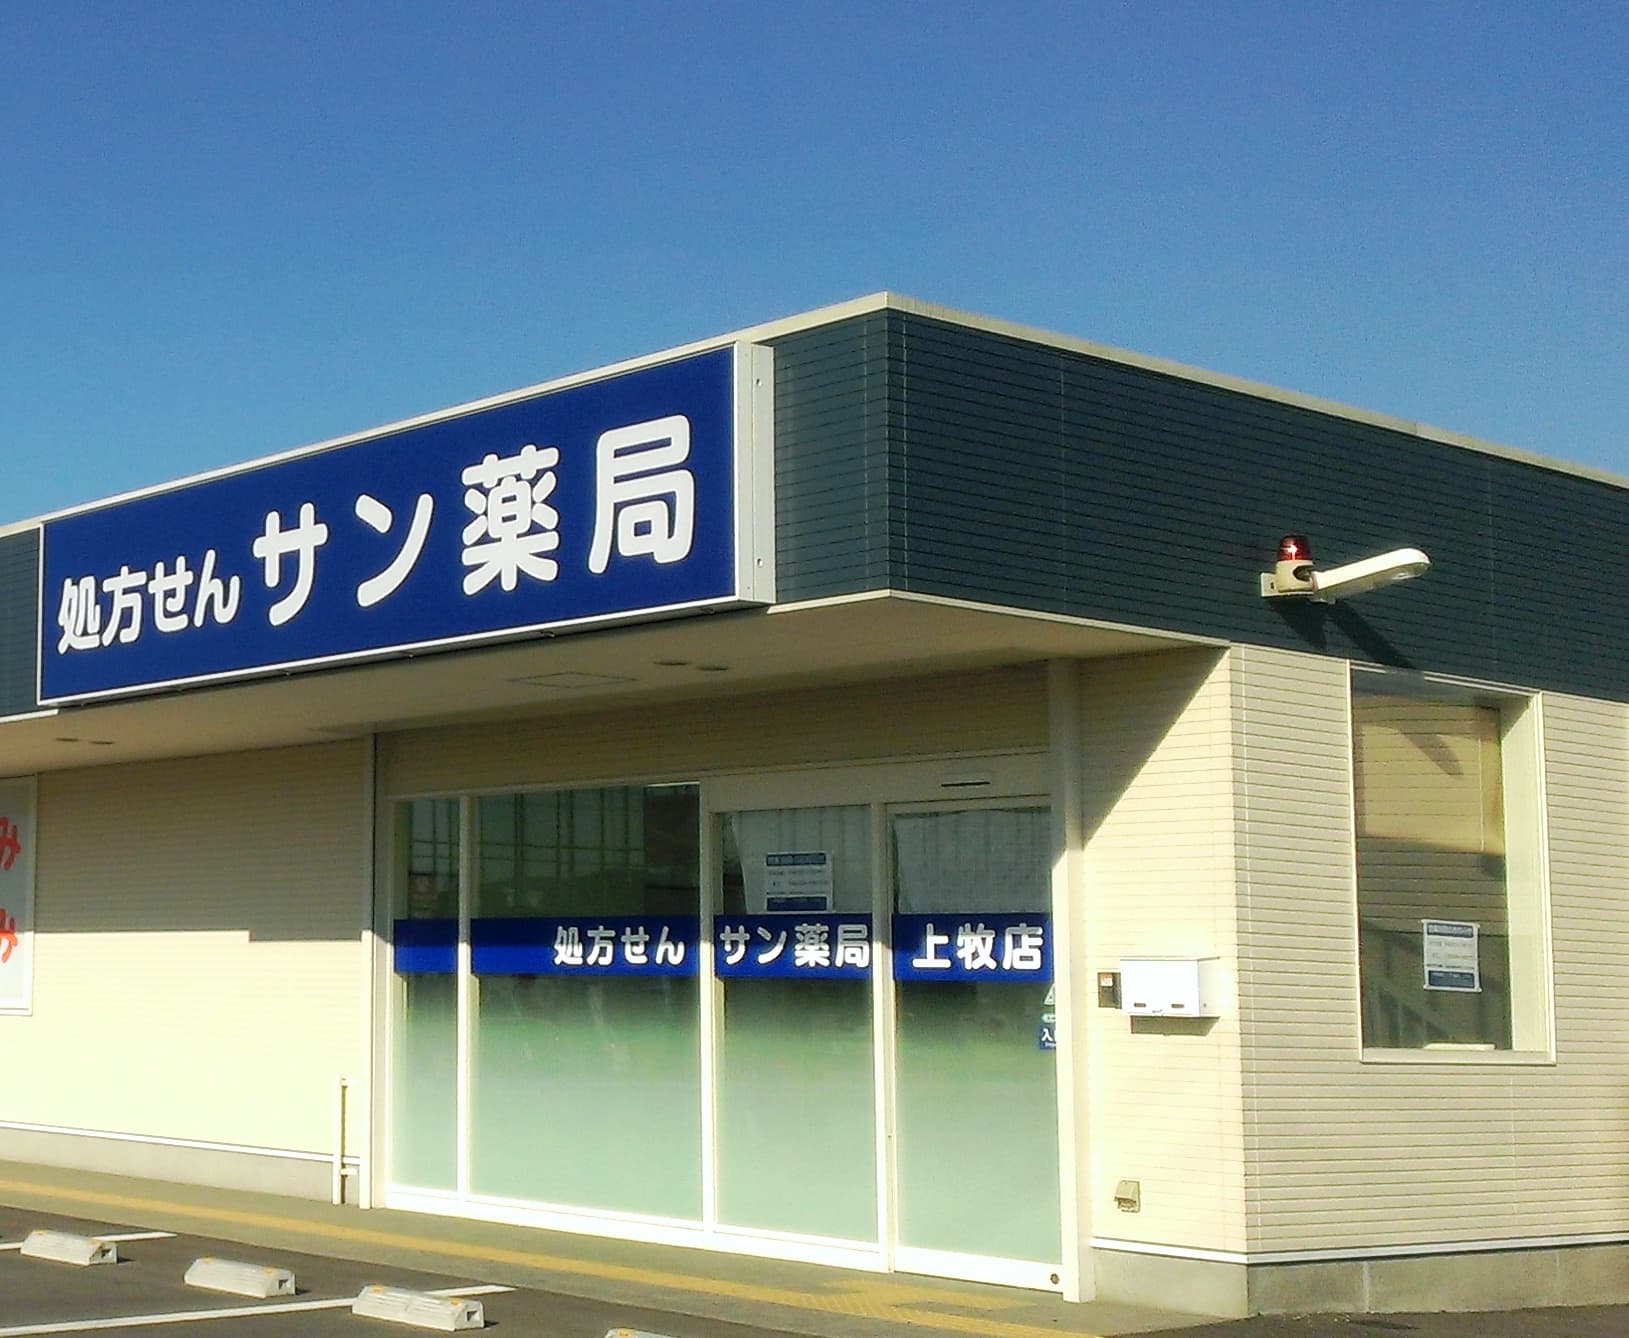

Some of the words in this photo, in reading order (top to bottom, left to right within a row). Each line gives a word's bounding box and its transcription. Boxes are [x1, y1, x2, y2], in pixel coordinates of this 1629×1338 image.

[57, 549, 241, 655] 処方せん
[252, 414, 696, 627] サン薬局
[553, 925, 685, 966] 処方せん
[719, 924, 873, 968] サン薬局
[911, 922, 1044, 971] 上牧店
